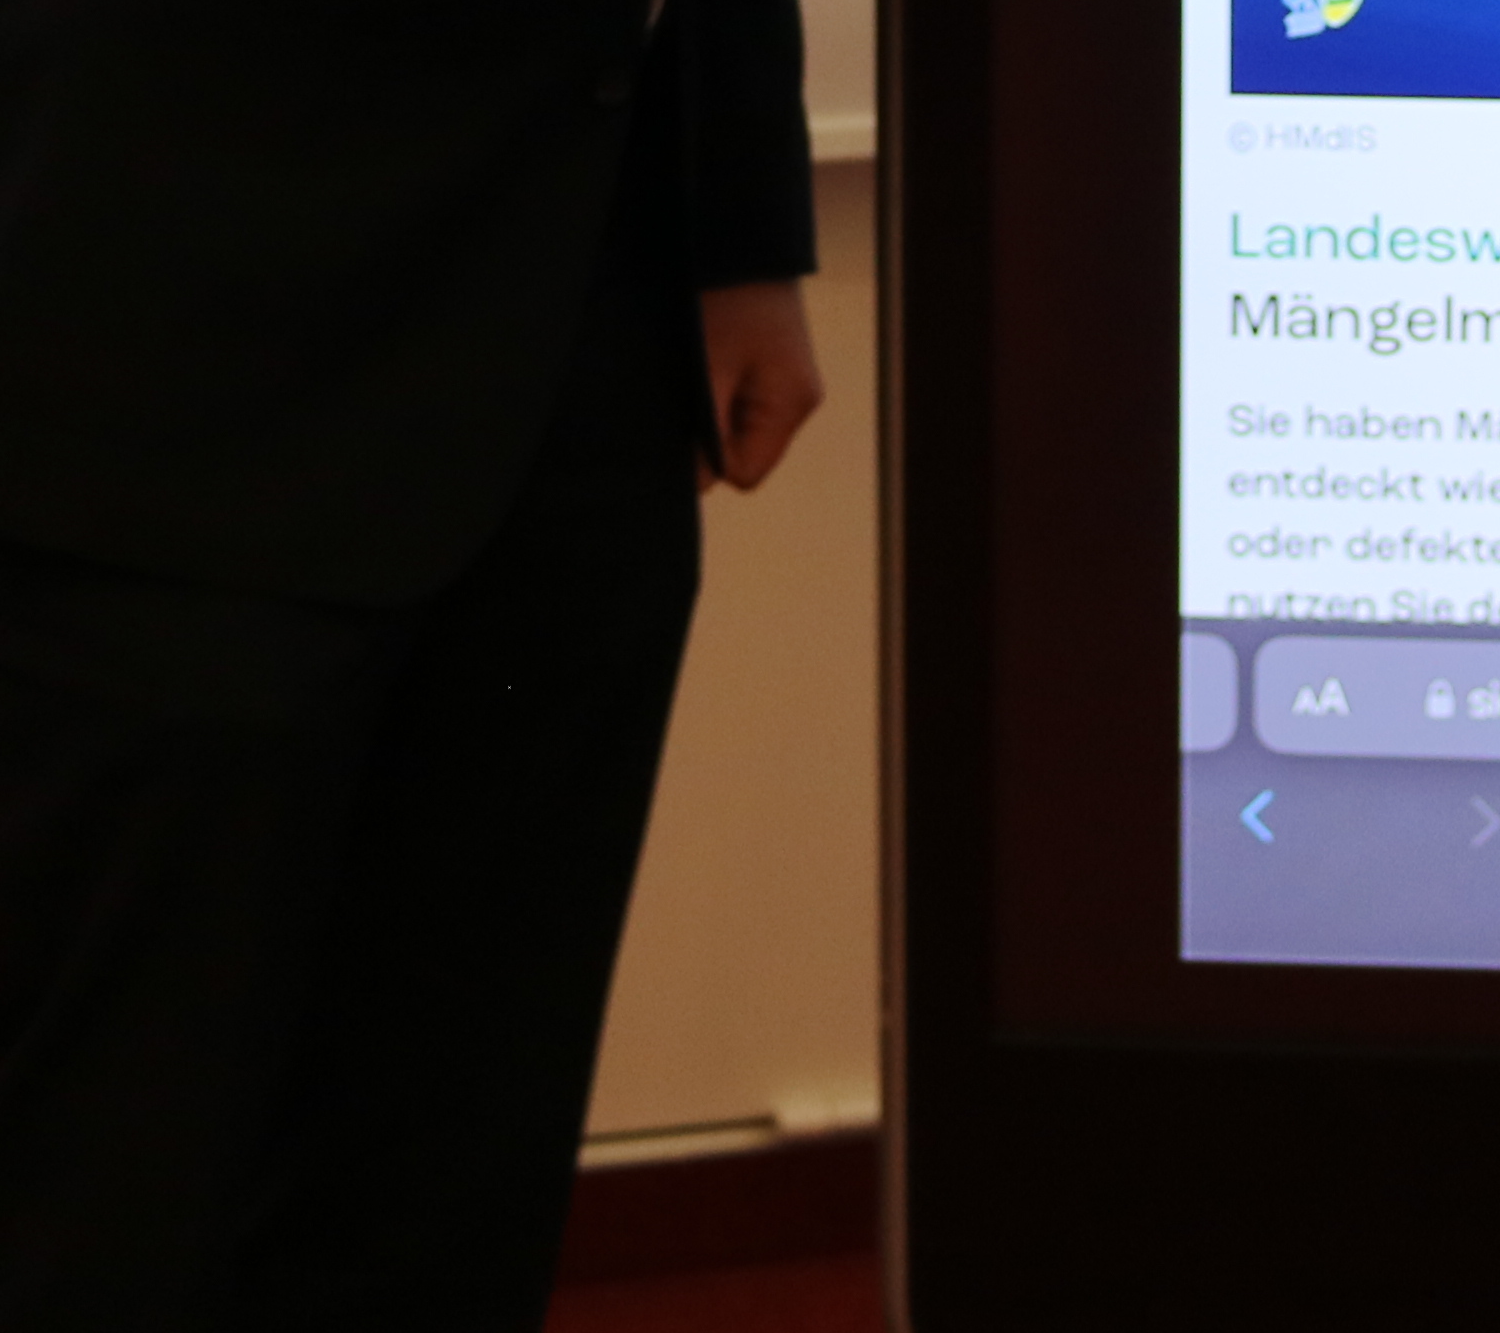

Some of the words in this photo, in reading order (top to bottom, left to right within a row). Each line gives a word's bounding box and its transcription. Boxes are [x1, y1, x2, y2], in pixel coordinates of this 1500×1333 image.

[1226, 402, 1293, 440] Sie
[1303, 403, 1444, 443] haben
[1226, 464, 1425, 504] entdeckt
[1226, 524, 1334, 562] oder
[1226, 587, 1378, 620] nutzen
[1389, 588, 1459, 623] Sie
